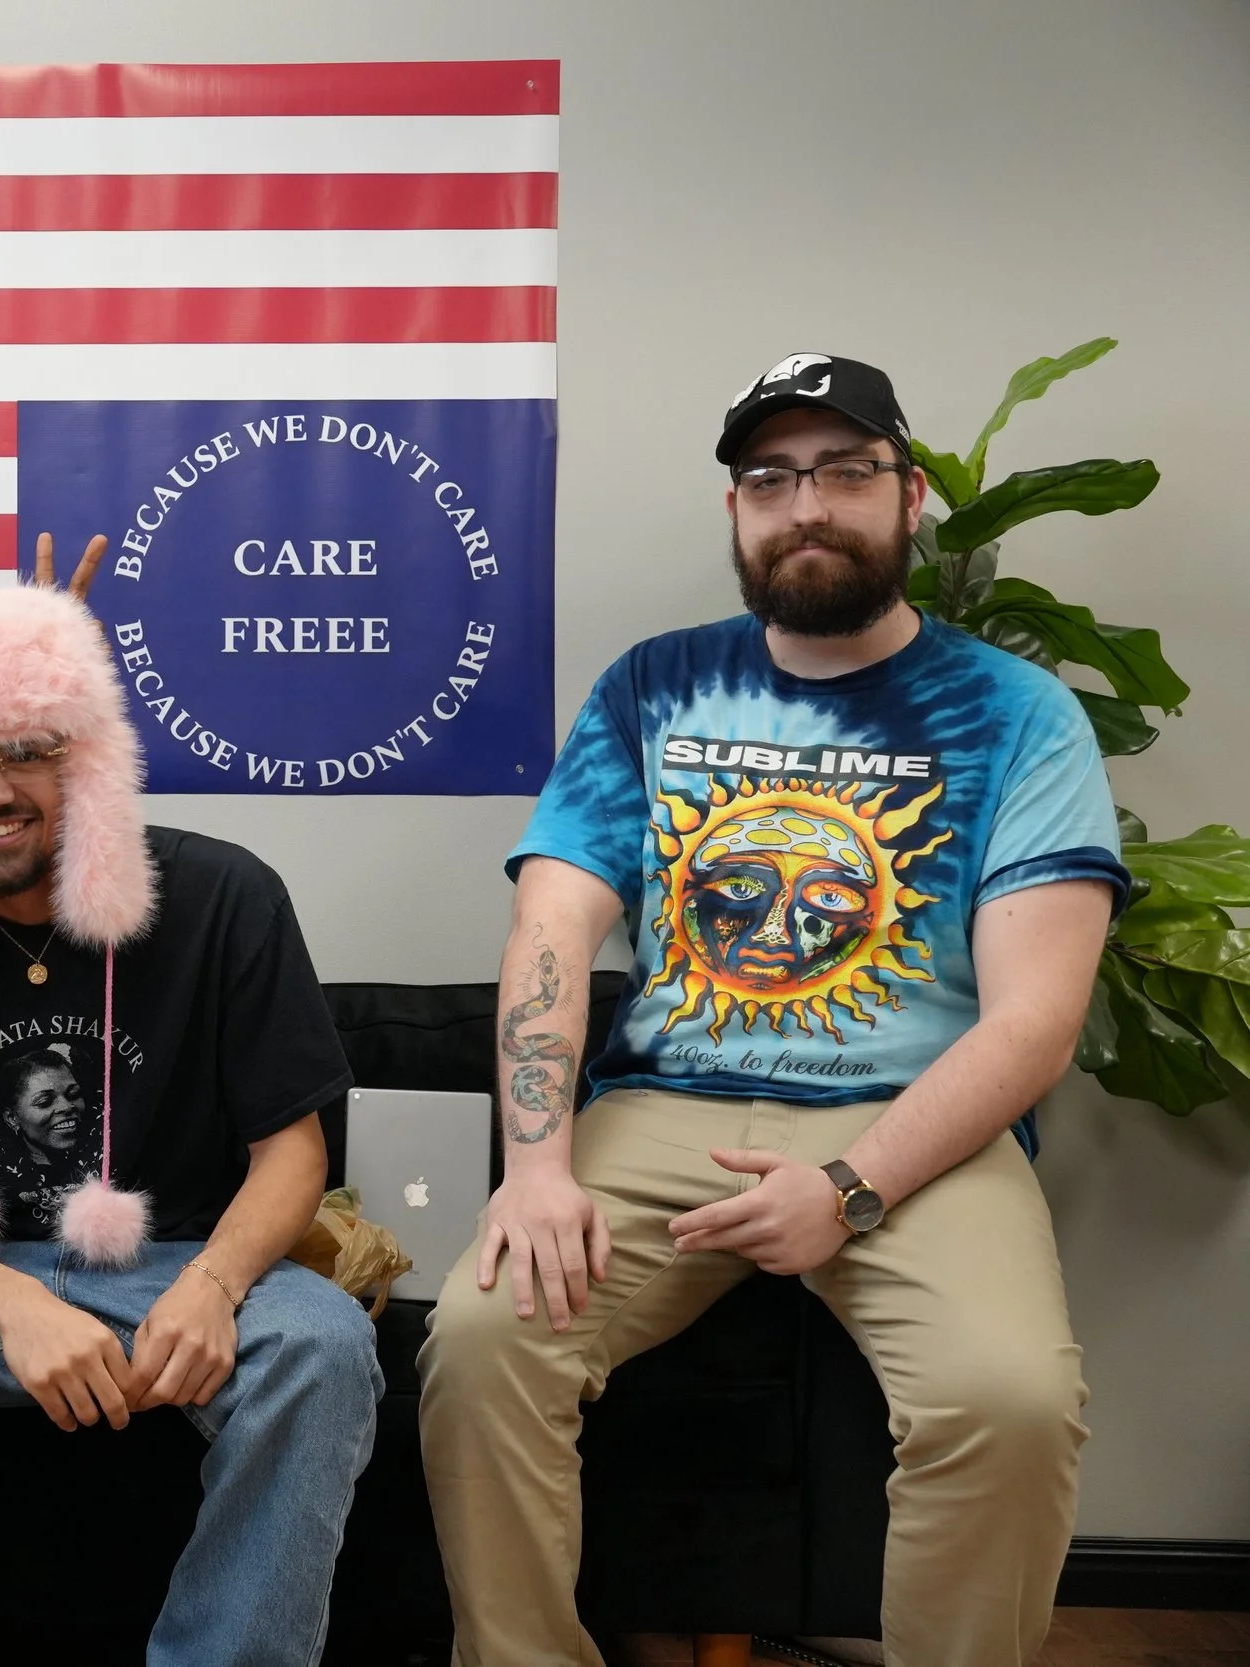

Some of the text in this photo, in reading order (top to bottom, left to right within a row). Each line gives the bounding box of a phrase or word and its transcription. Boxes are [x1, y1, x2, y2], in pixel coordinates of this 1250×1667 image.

[114, 414, 500, 582] BECAUSE WE DON'T CARE
[233, 539, 378, 577] CARE
[220, 616, 391, 654] FREEE
[114, 618, 496, 788] BECAUSE WE DON'T CARE
[663, 739, 933, 779] SUBLIME
[738, 1049, 763, 1071] to
[766, 1049, 878, 1080] freedom
